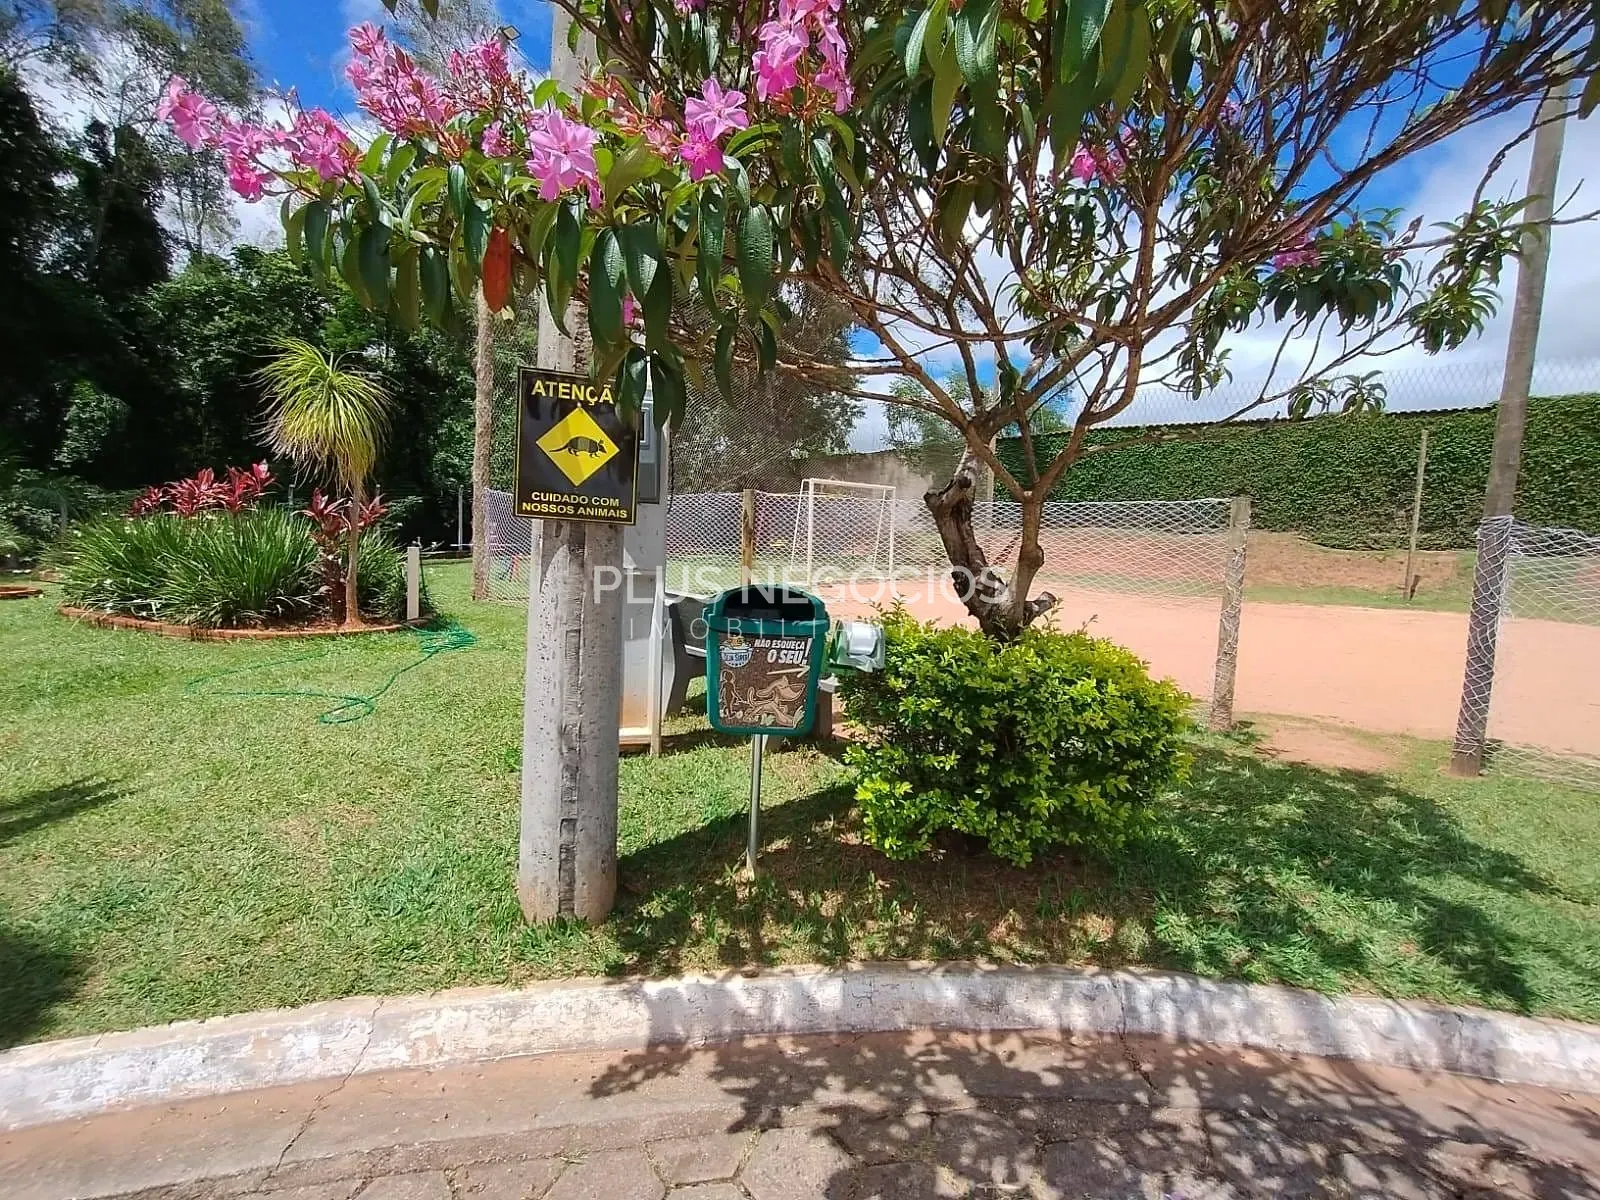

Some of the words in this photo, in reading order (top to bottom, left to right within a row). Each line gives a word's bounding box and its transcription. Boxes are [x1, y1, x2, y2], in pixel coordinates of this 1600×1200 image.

[531, 379, 614, 406] ATENÇÃ
[531, 491, 589, 505] CUIDADO
[591, 496, 620, 507] COM
[521, 502, 575, 515] NOSSOS
[577, 506, 628, 519] ANIMAIS
[771, 639, 806, 650] ESQUEÇA
[767, 648, 778, 664] O
